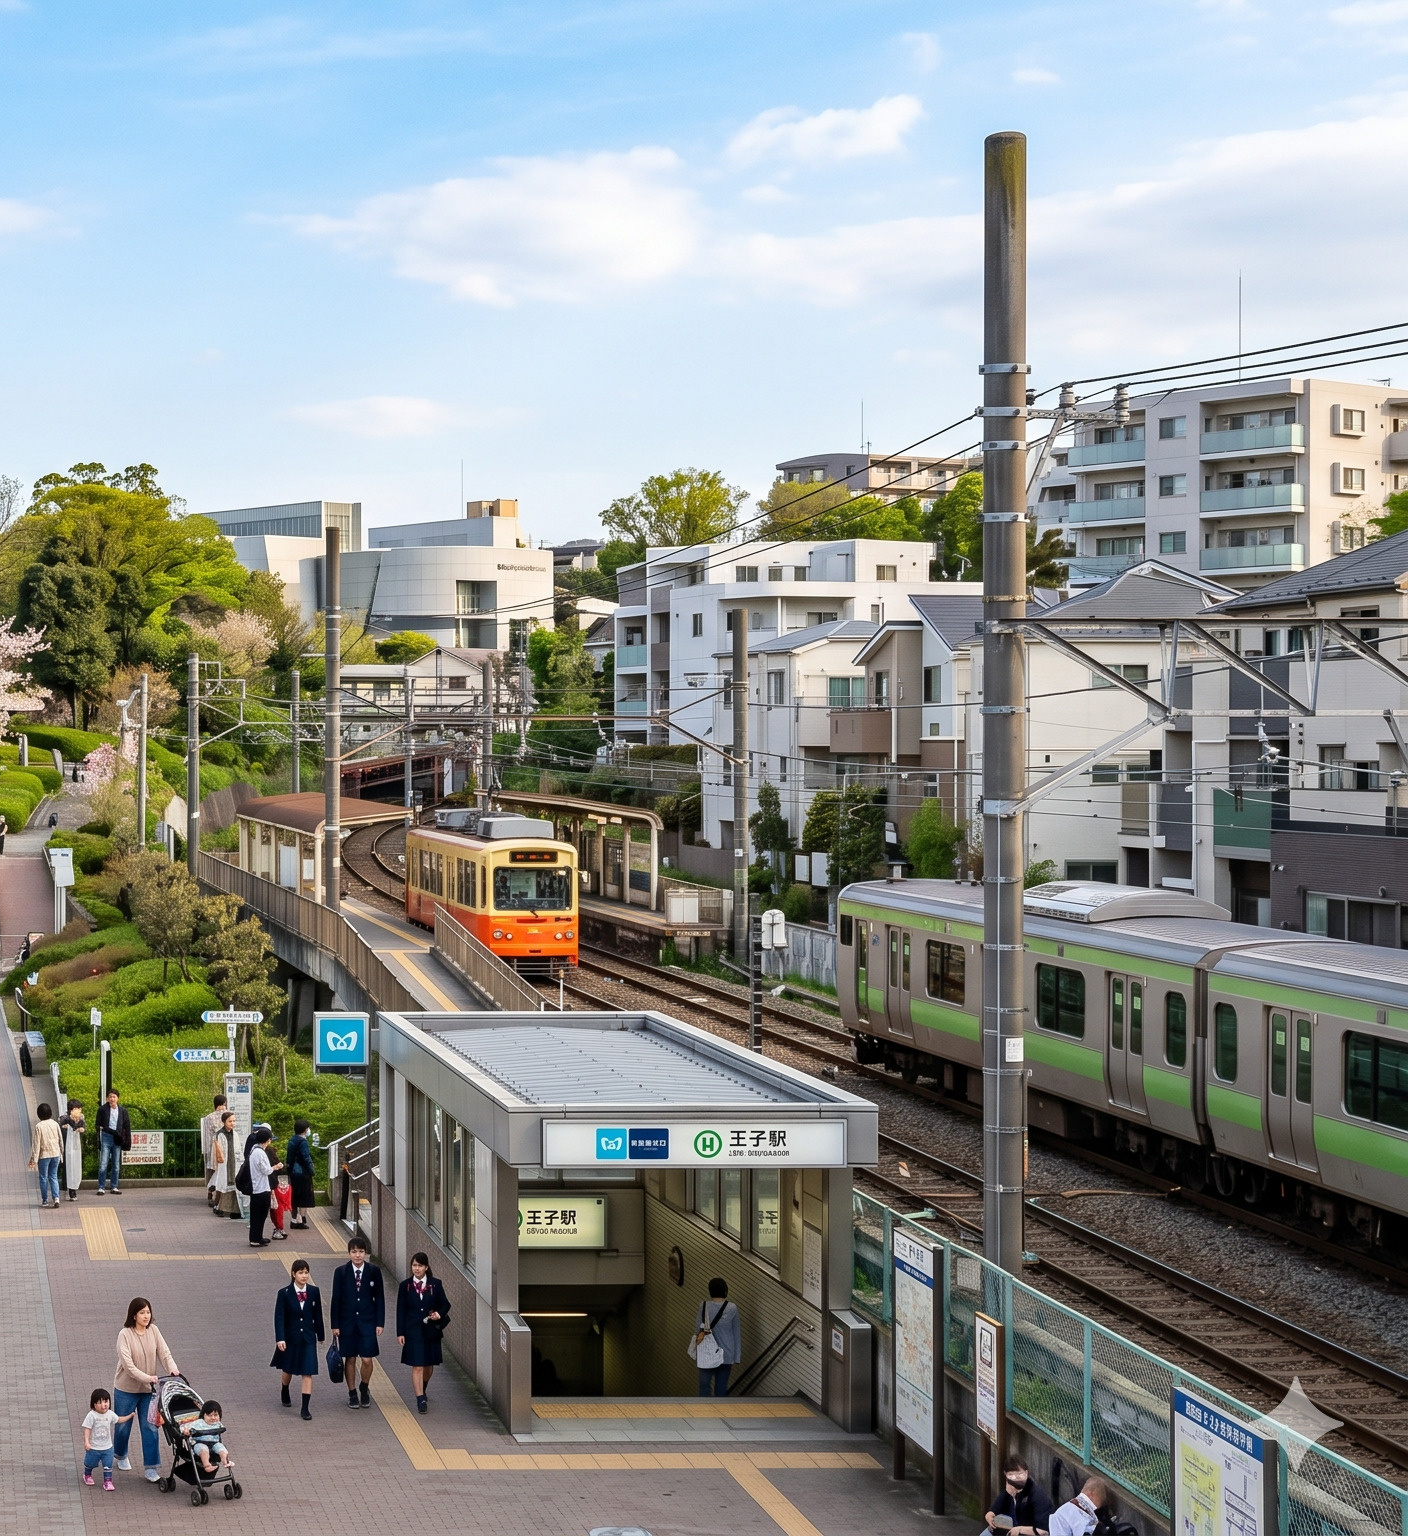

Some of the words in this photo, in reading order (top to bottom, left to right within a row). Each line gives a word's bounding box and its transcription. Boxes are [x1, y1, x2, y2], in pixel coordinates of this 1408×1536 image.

[702, 1137, 714, 1152] H
[729, 1130, 787, 1148] 王子駅
[526, 1210, 577, 1226] 王子駅
